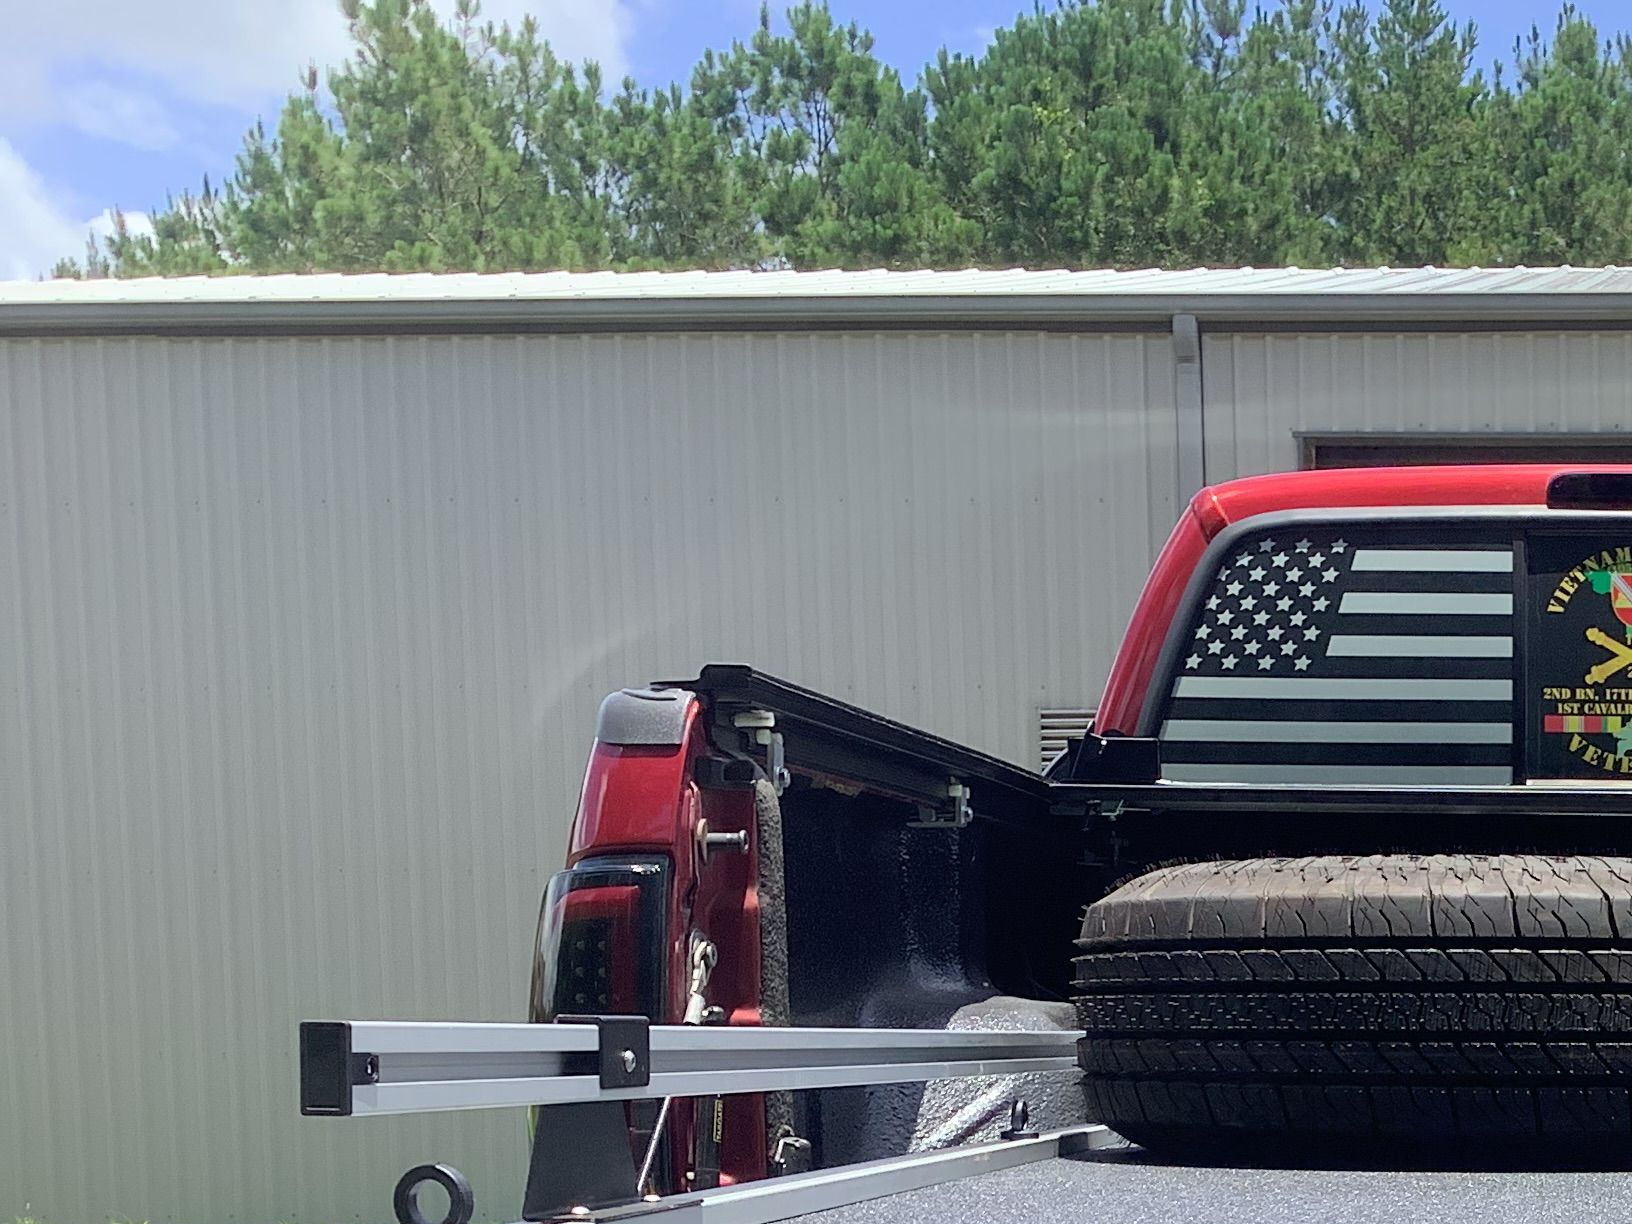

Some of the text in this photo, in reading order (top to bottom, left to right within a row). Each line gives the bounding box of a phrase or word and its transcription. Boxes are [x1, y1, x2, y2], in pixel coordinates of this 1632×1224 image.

[1546, 546, 1632, 613] VIETNAM
[1543, 688, 1571, 701] 2ND
[1557, 703, 1581, 715] 1ST
